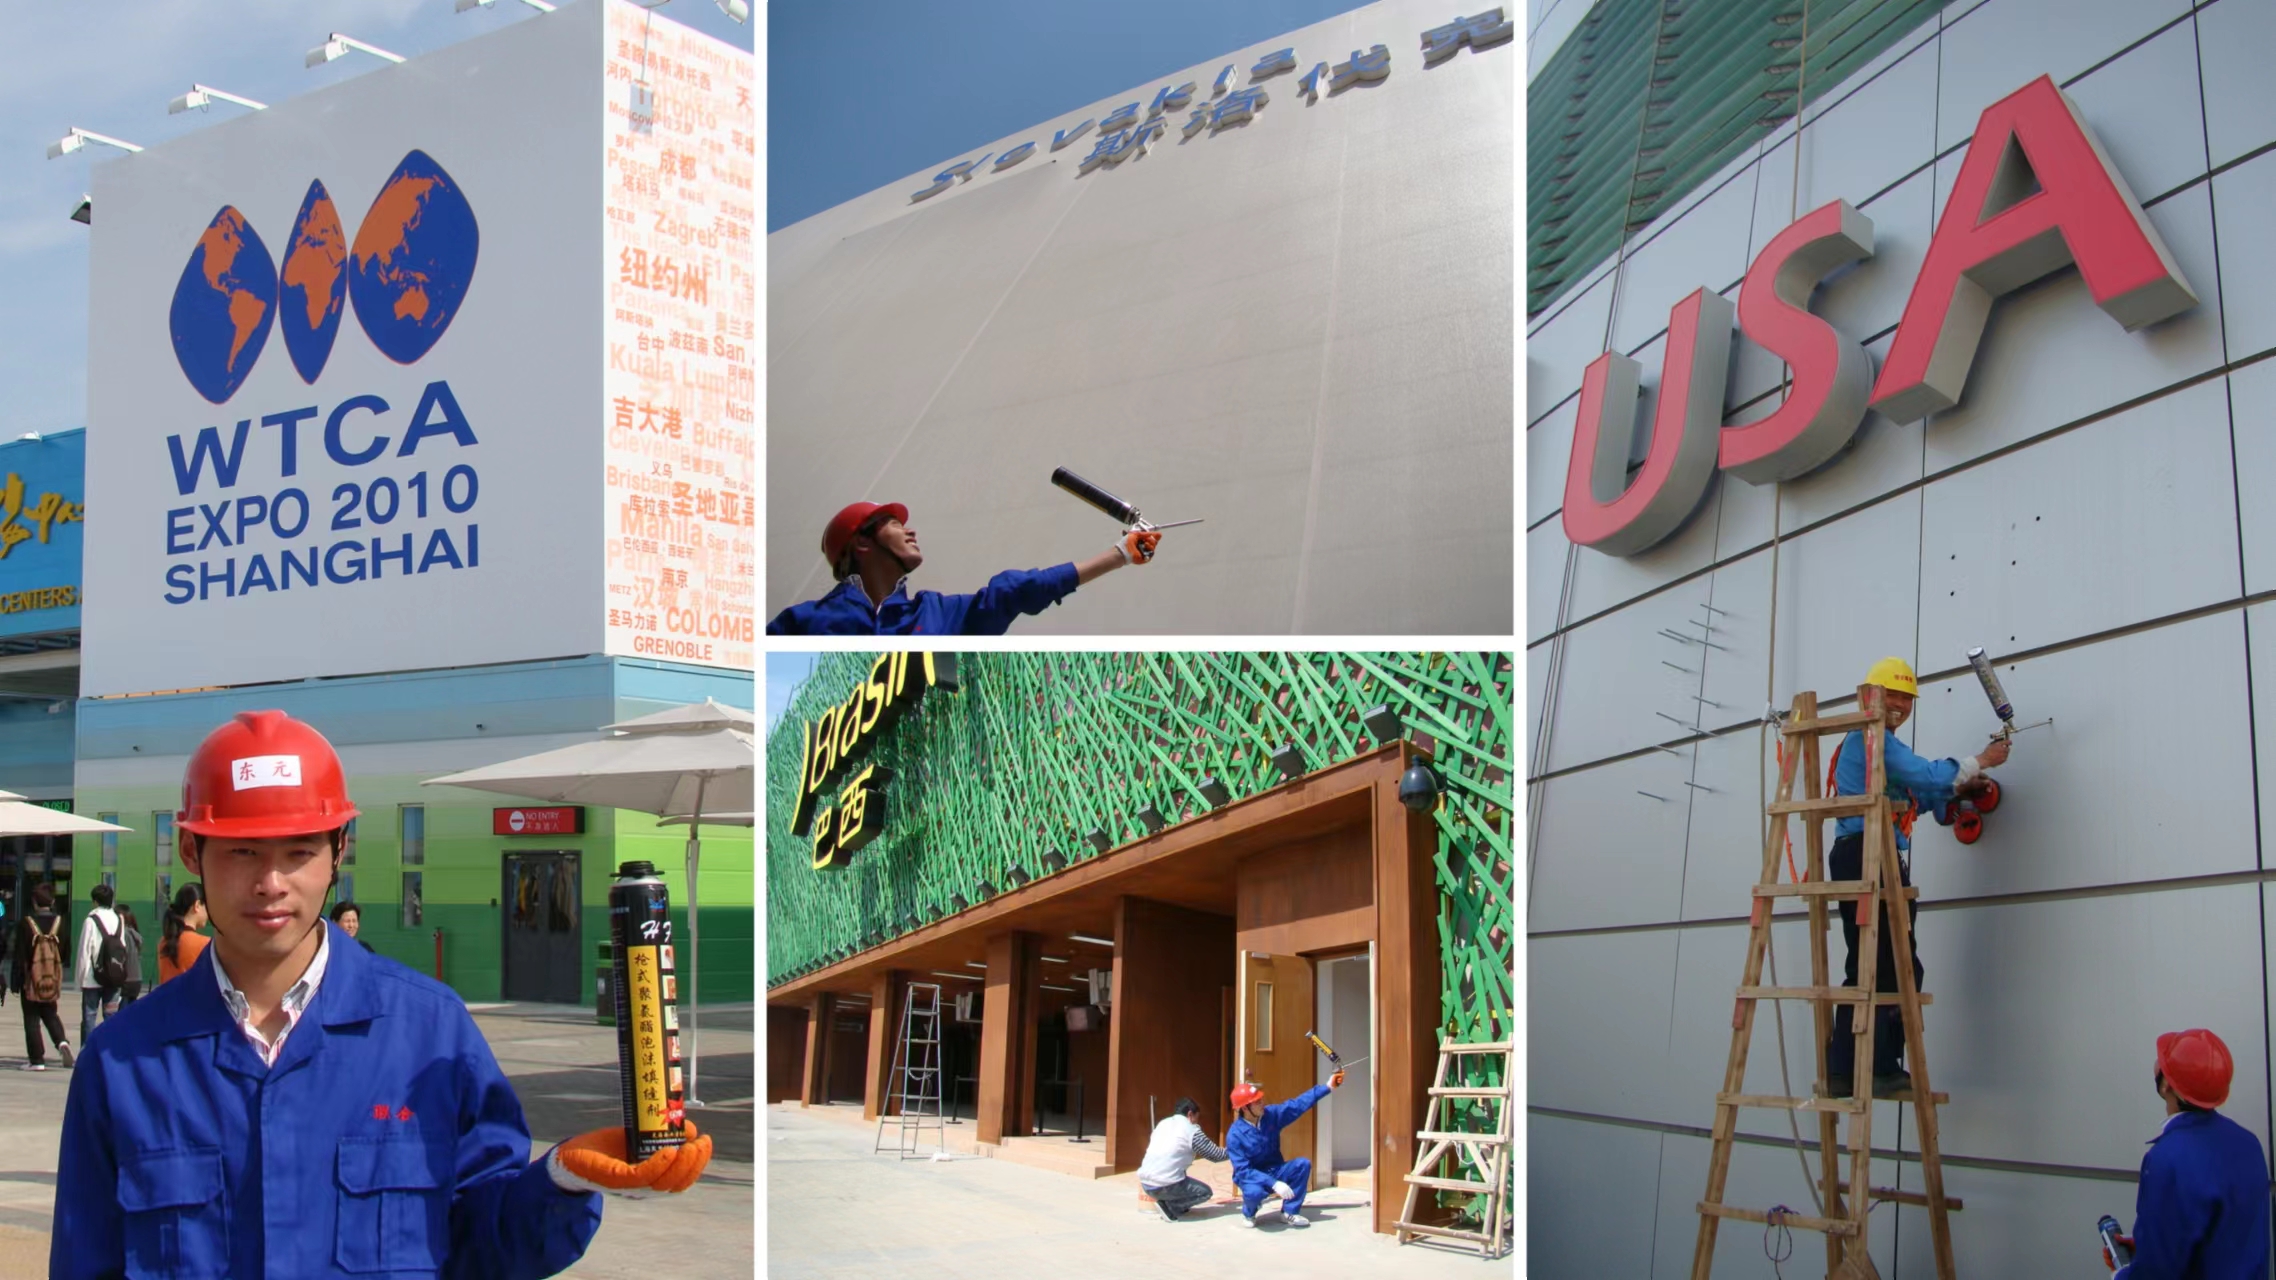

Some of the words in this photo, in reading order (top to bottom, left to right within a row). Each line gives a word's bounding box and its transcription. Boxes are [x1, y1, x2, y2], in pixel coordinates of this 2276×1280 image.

[659, 147, 698, 181] 成都
[654, 209, 720, 249] Zagreb
[619, 244, 709, 307] 纽约州
[1562, 73, 2200, 557] USA
[637, 331, 665, 352] 台中
[713, 334, 746, 363] San
[609, 342, 675, 383] Kuala
[612, 394, 683, 440] 吉大港
[166, 380, 479, 495] WTCA
[165, 487, 310, 556] EXPO
[329, 464, 480, 532] 2010
[620, 502, 704, 548] Manila
[163, 523, 480, 605] SHANGHAI
[661, 567, 690, 589] 南京
[608, 583, 633, 596] METZ
[666, 605, 754, 643] COLOMB
[633, 635, 713, 661] GRENOBLE
[525, 812, 537, 821] NO
[538, 811, 560, 821] ENTRY
[812, 763, 876, 871] 巴西
